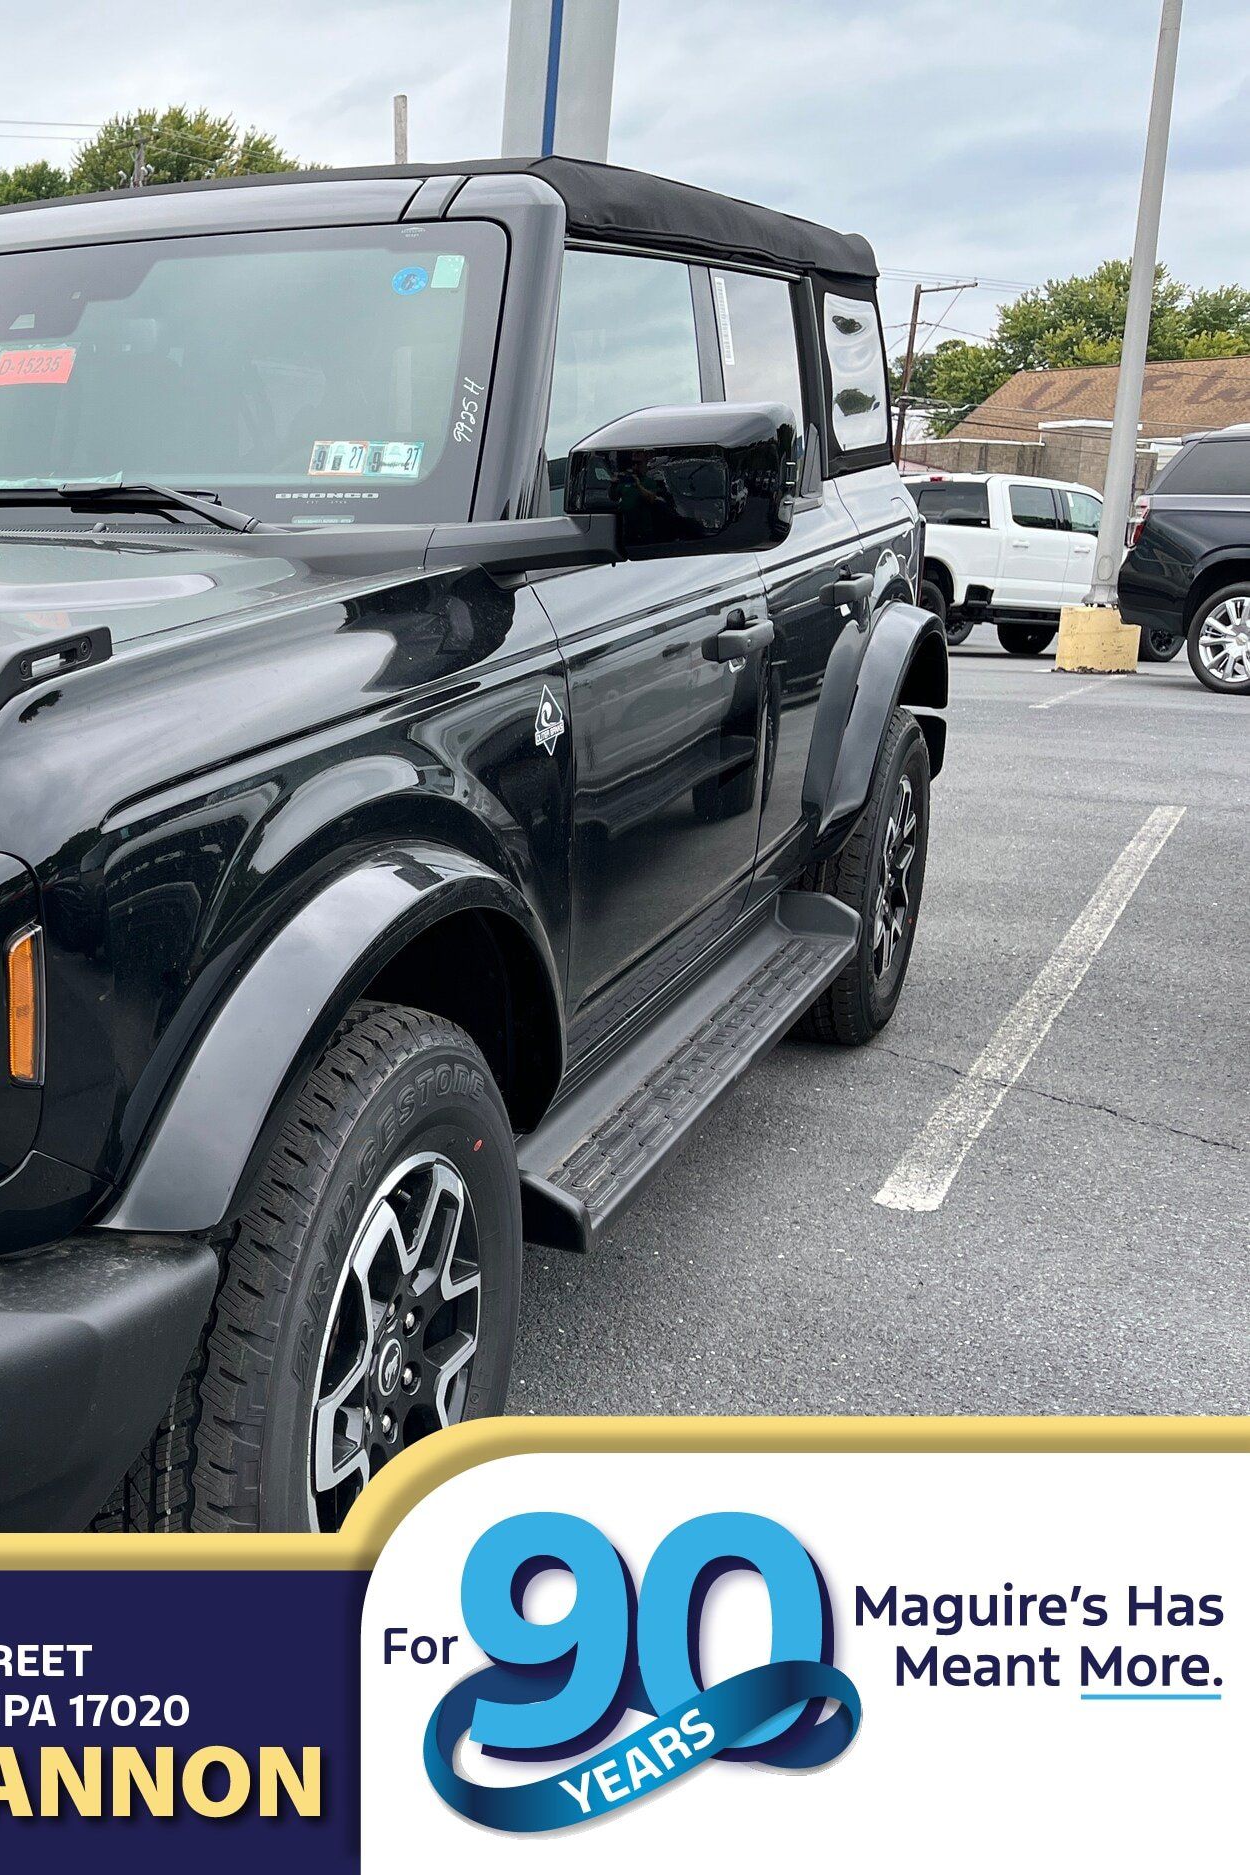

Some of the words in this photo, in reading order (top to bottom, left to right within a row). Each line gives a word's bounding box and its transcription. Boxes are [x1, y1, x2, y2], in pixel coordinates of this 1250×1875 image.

[463, 376, 485, 395] H
[453, 396, 479, 442] 9925
[349, 446, 364, 469] 27
[404, 447, 420, 471] 27
